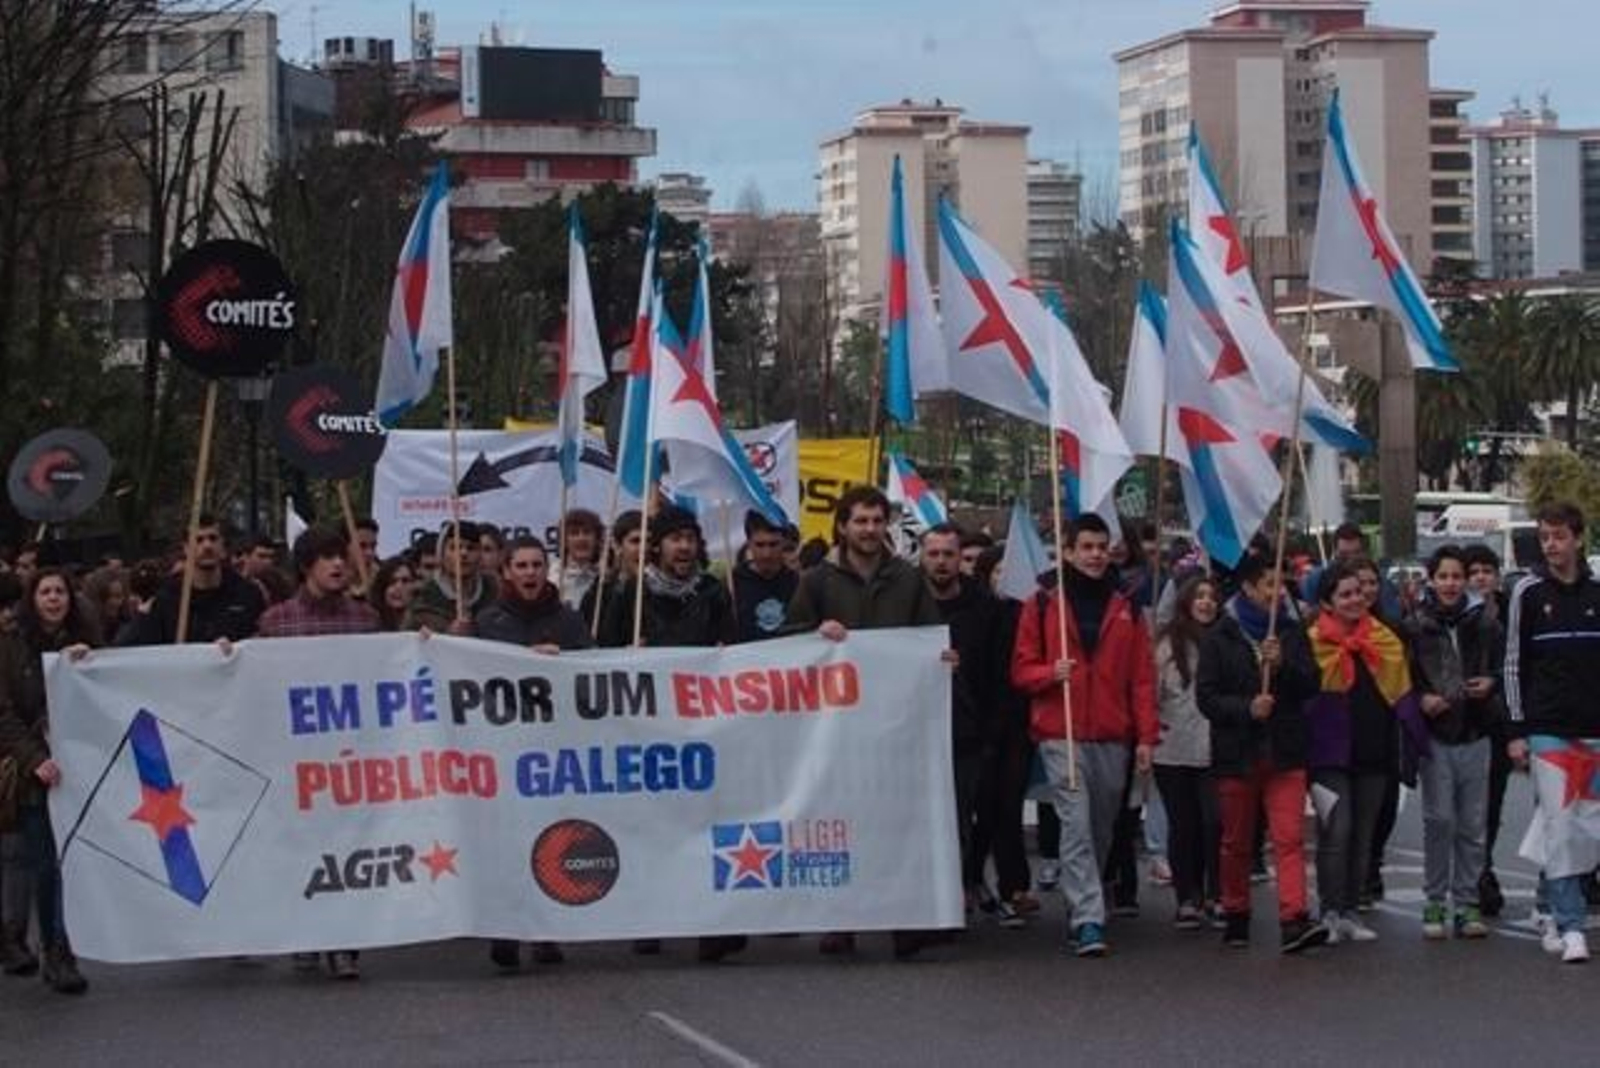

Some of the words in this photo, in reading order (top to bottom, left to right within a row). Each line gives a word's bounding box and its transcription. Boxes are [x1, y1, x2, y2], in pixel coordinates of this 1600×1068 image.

[205, 291, 296, 329] COMITÉS
[318, 410, 386, 435] COMITÉS
[288, 683, 361, 735] EM
[376, 667, 438, 729] PÉ
[449, 675, 554, 726] POR
[575, 671, 656, 720] UM
[672, 661, 860, 719] ENSINO
[295, 748, 499, 811] PÚBLICO
[515, 742, 716, 799] GALEGO
[304, 843, 416, 900] AGIR
